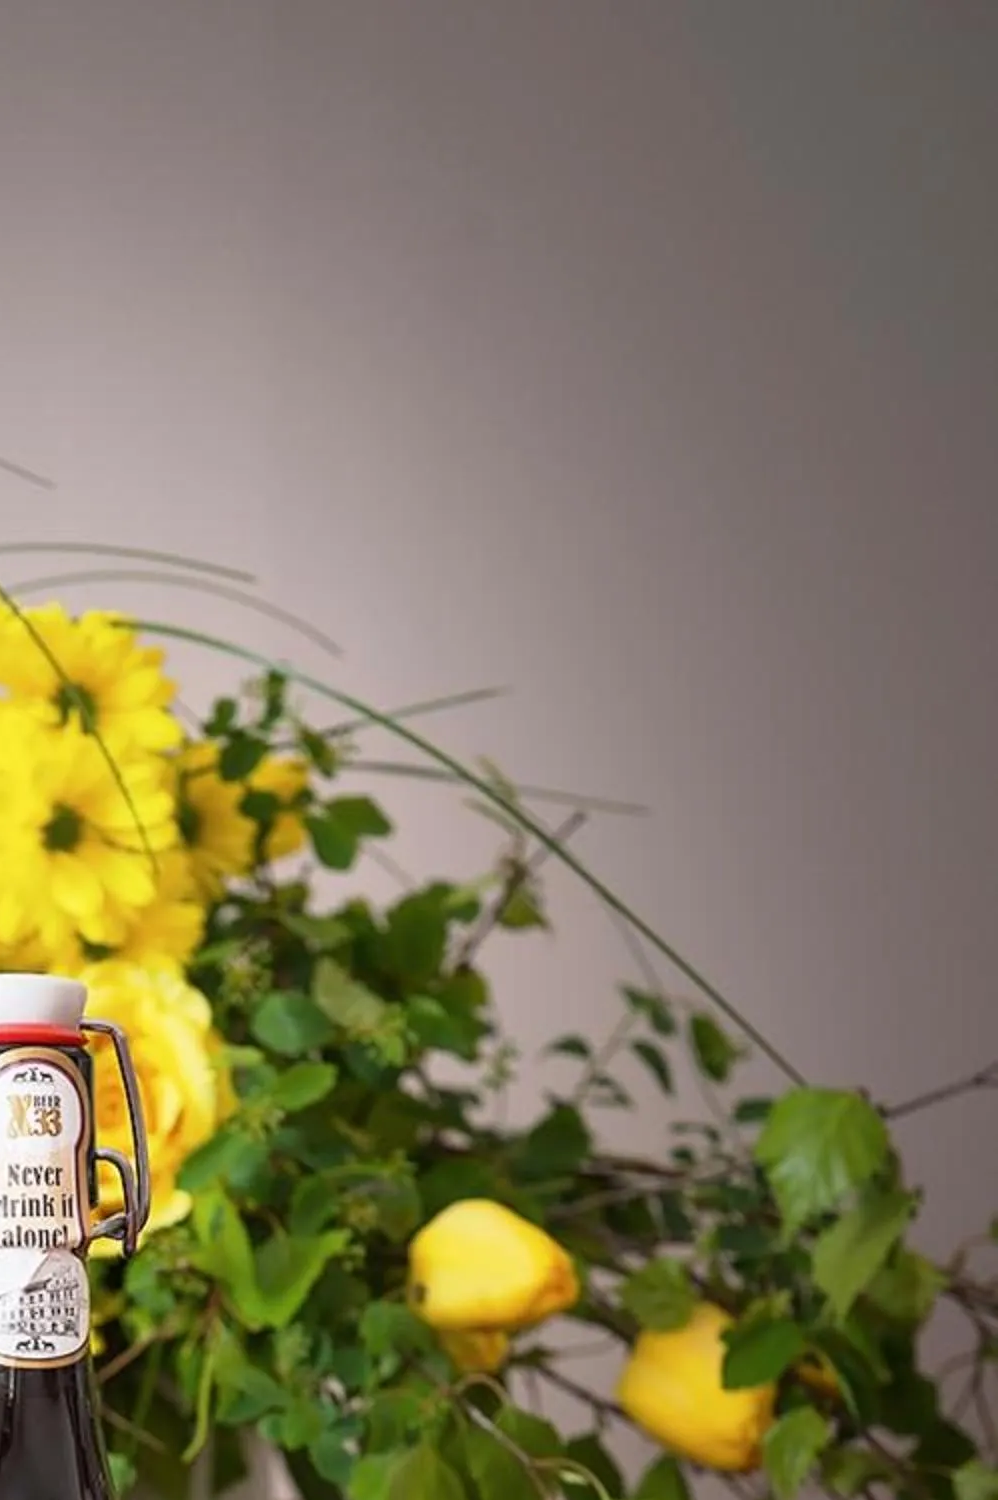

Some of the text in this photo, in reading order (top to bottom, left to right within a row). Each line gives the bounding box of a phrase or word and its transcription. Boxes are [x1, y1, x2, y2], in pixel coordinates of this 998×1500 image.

[34, 1096, 61, 1107] BEER
[8, 1164, 63, 1187] Never
[61, 1193, 75, 1219] it
[2, 1224, 69, 1250] alone!
